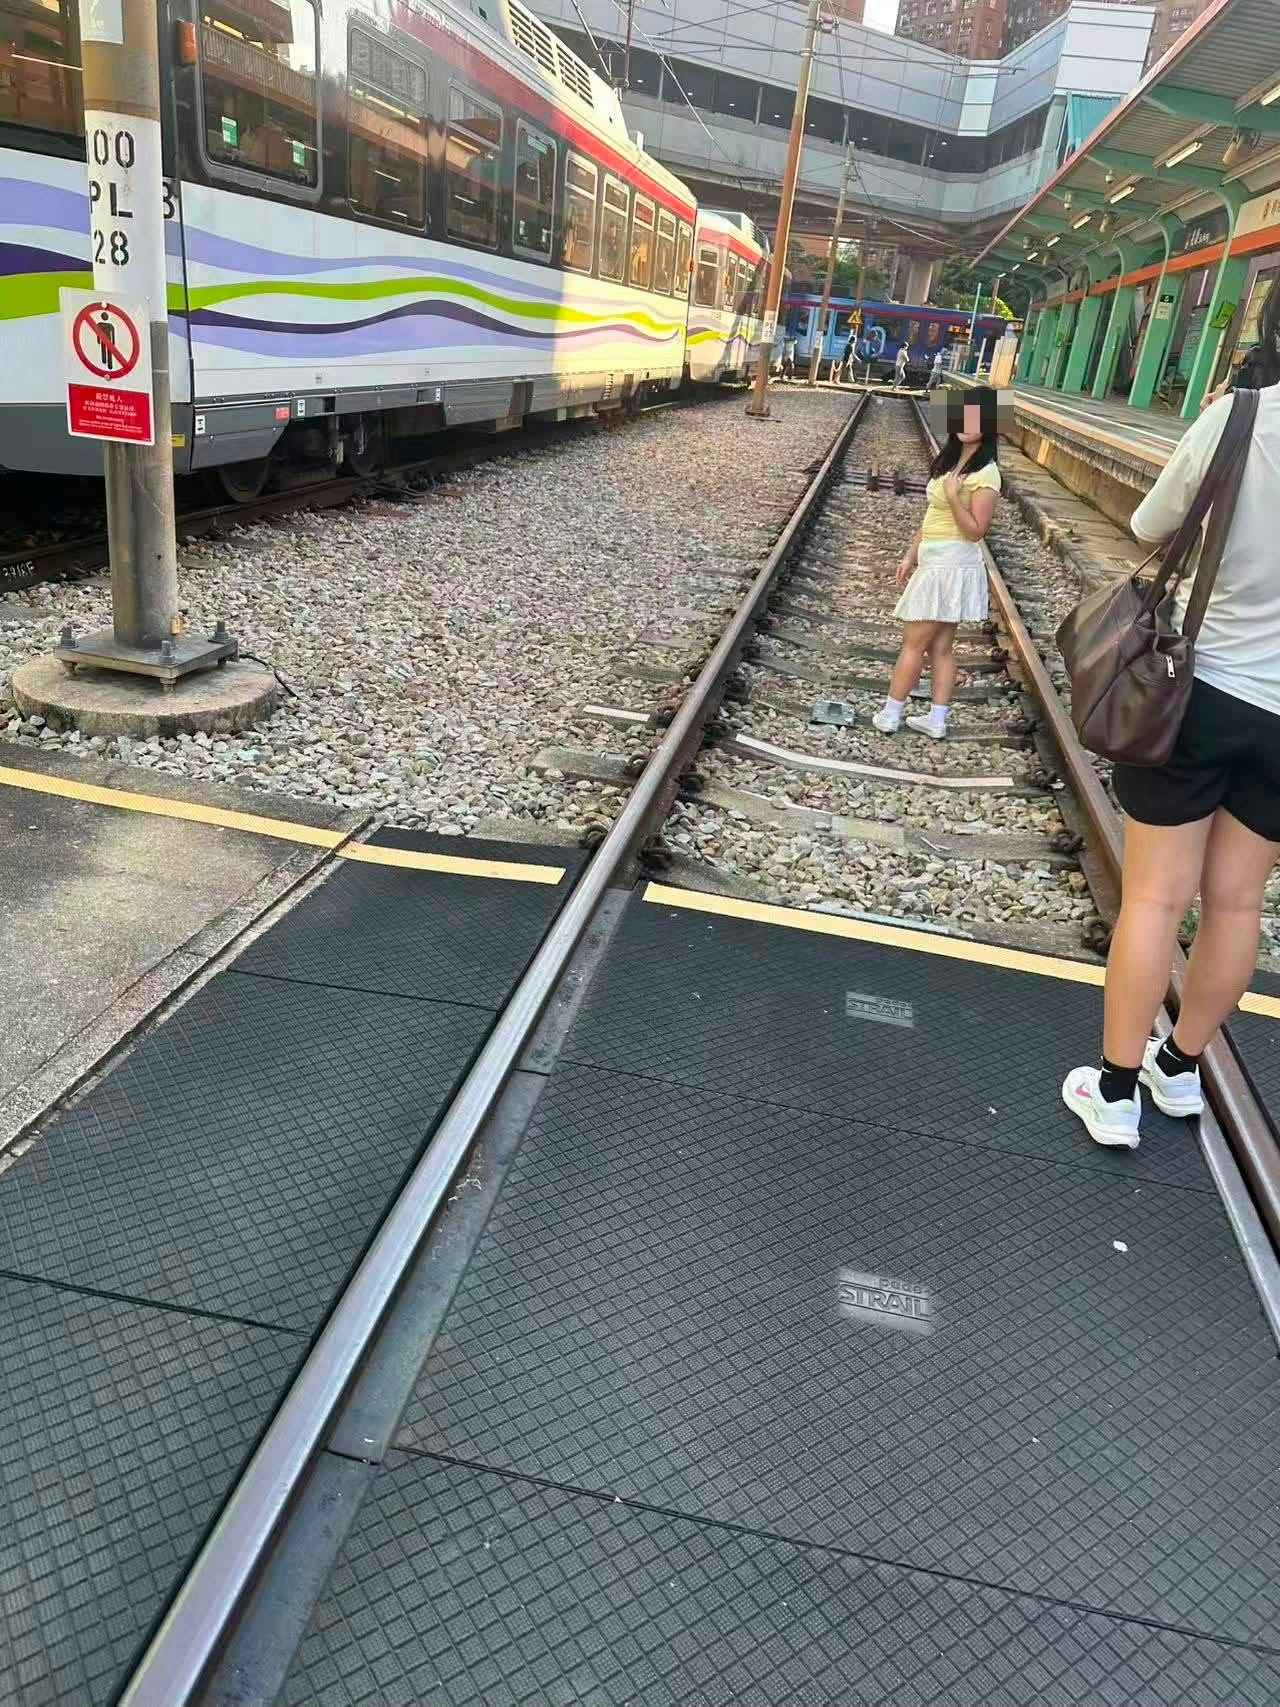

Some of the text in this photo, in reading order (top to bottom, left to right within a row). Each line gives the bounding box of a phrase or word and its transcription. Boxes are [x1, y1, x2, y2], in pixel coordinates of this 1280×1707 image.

[87, 129, 135, 169] 00
[89, 180, 133, 218] PL
[94, 230, 129, 266] 28
[848, 1000, 912, 1019] STRAIL
[840, 1283, 931, 1317] STRAIL
